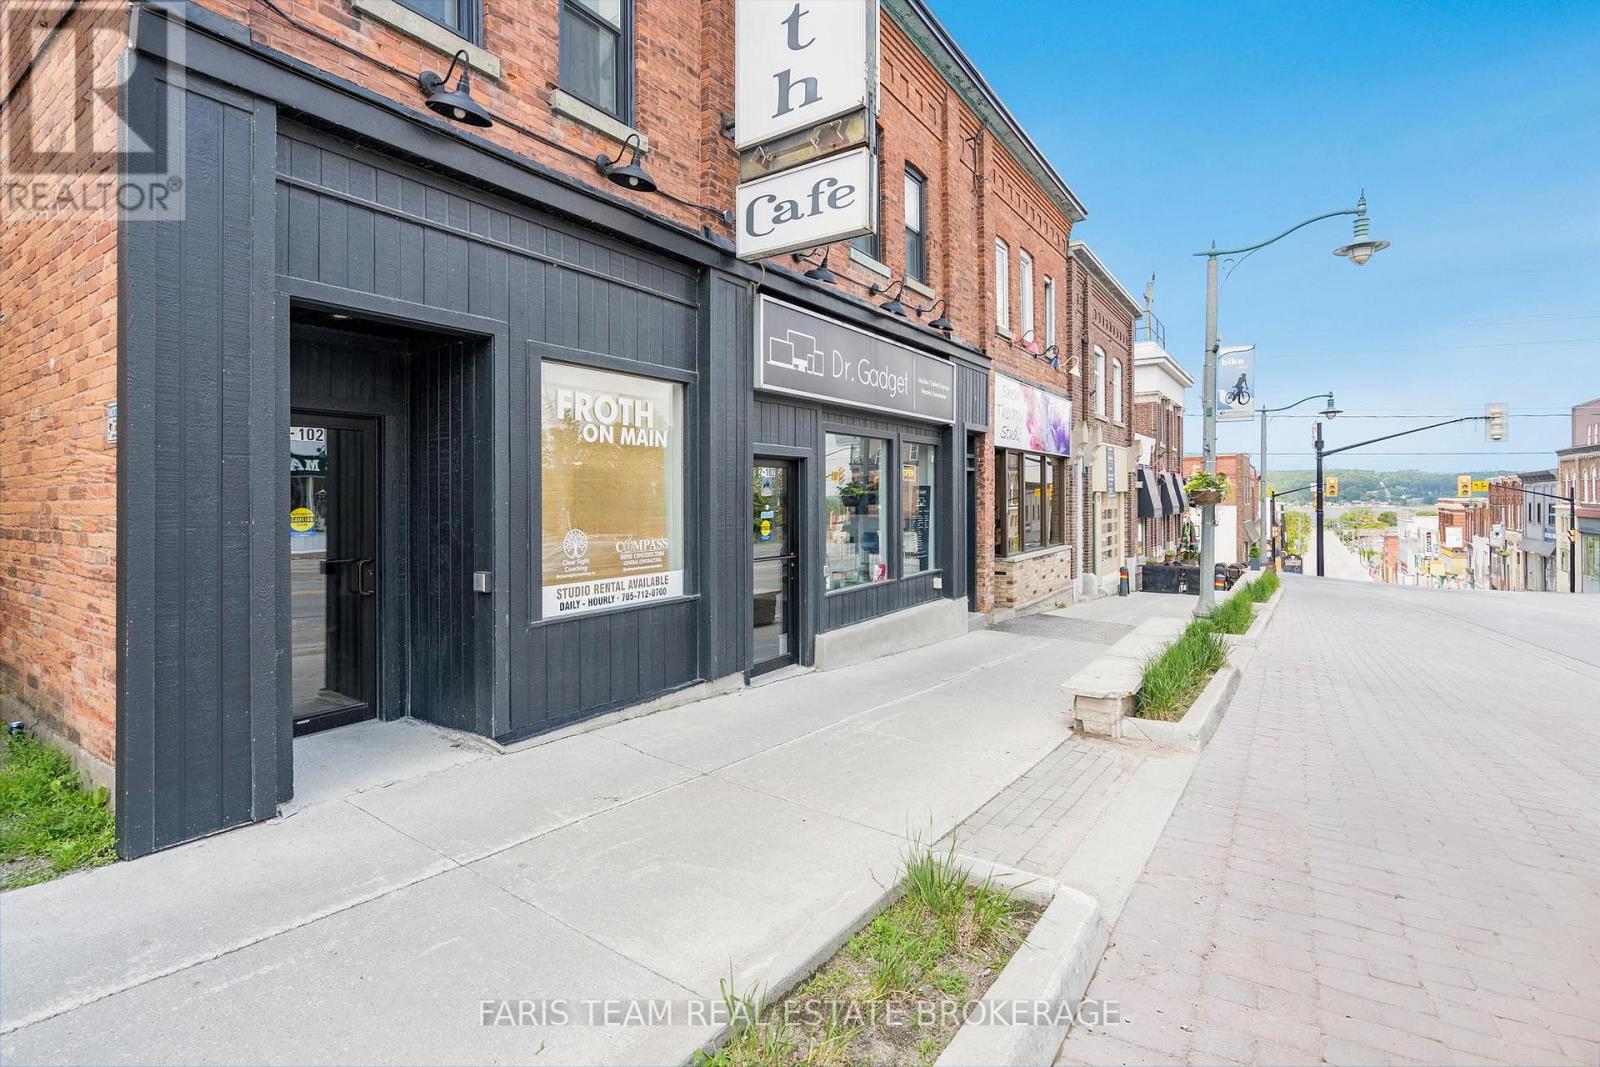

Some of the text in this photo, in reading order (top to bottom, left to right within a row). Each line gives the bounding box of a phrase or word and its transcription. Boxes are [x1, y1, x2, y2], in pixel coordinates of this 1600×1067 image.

[745, 177, 855, 237] Cafe
[832, 350, 909, 397] Dr. Gadget
[556, 389, 655, 428] FROTH
[582, 423, 668, 448] ON MAIN
[556, 575, 669, 600] STUDIO RENTAL AVAILABLE
[560, 601, 580, 611] DAILY
[588, 595, 615, 607] HOURLY
[621, 587, 667, 602] 705-712-0700
